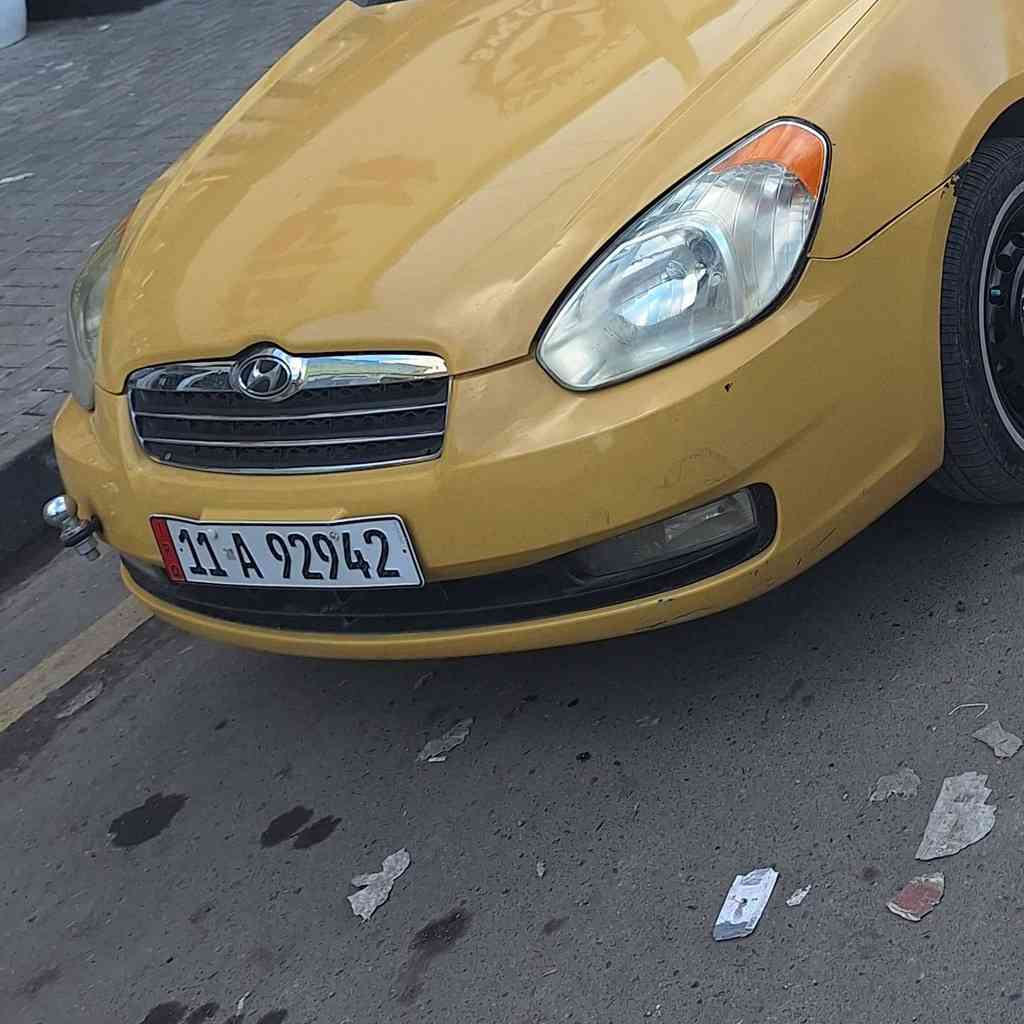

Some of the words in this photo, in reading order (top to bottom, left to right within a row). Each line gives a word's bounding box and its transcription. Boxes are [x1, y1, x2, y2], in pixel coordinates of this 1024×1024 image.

[178, 529, 227, 577] 11
[232, 533, 264, 579] A
[266, 529, 401, 580] 92942
